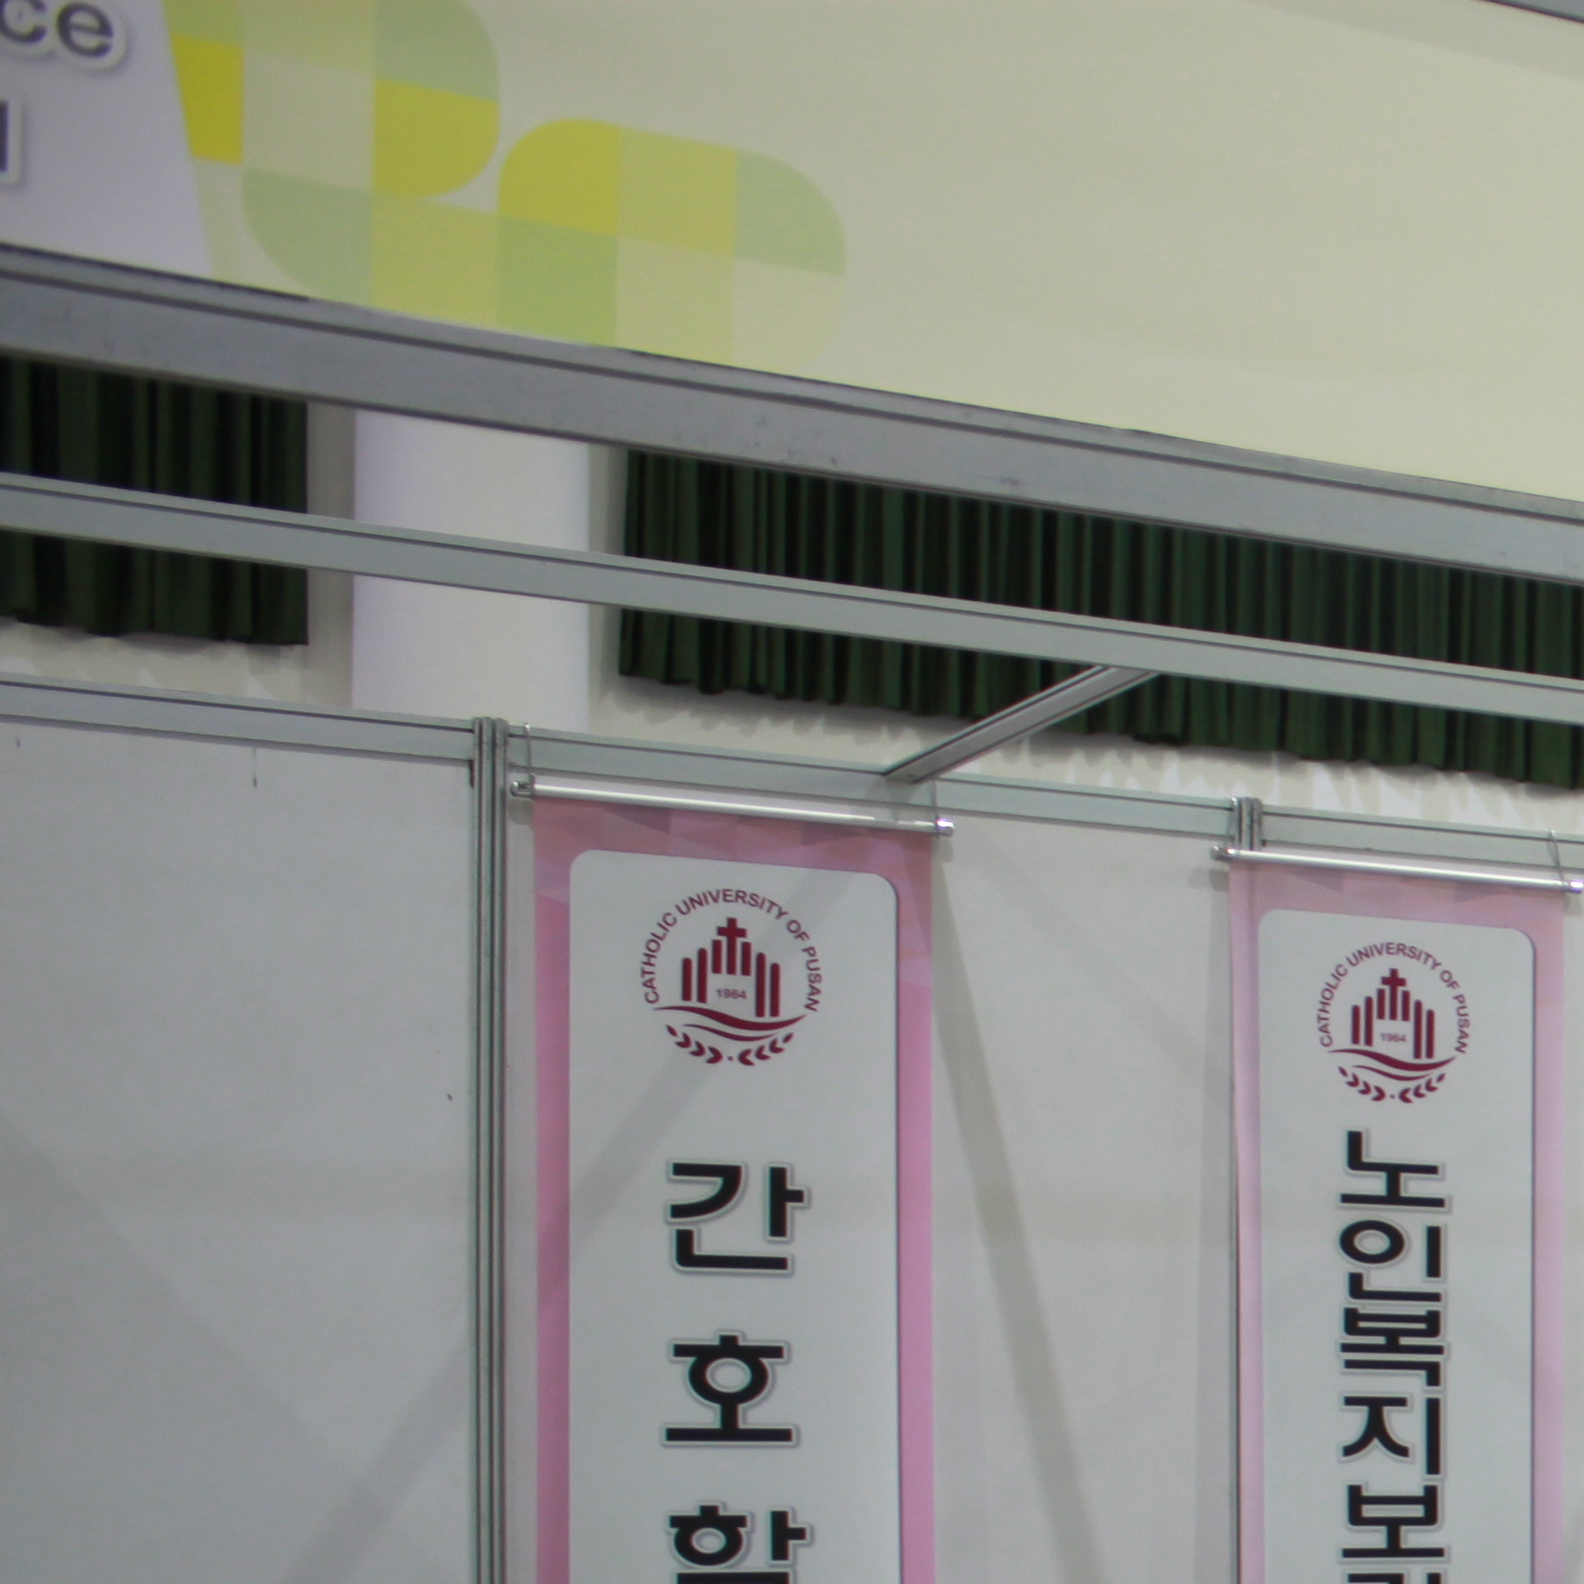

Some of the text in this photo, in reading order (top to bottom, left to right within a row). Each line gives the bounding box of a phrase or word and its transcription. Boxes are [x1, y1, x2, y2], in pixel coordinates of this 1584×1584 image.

[641, 888, 822, 1012] CATHOLIC UNIVERSITY OF PUSAN
[1316, 942, 1470, 1054] CATHOLIC UNIVERSITY OF PUSAN
